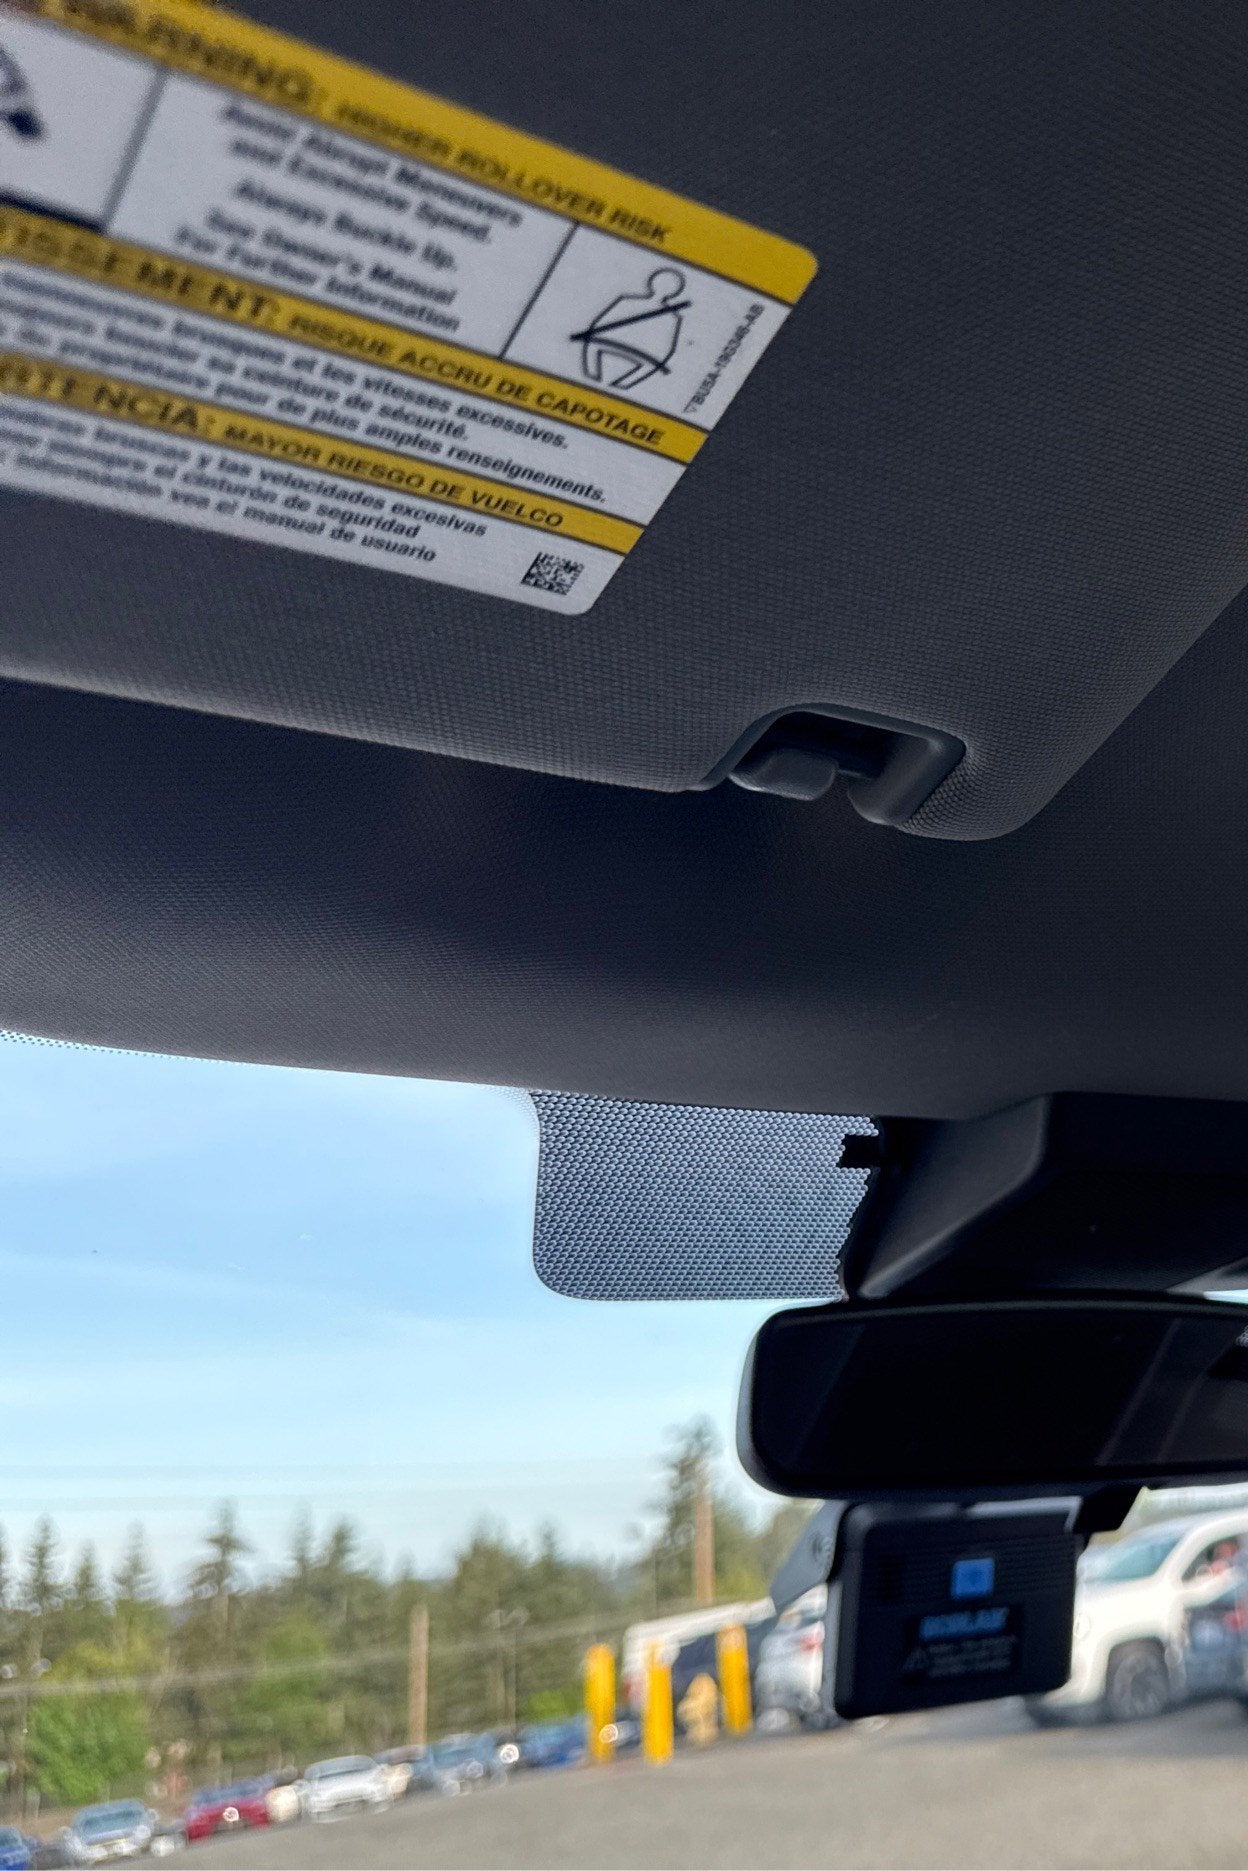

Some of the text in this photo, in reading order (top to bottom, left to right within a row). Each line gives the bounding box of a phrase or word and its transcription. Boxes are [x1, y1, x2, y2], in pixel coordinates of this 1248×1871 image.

[415, 201, 492, 243] Speed.
[453, 149, 605, 217] ROLLOVER
[607, 208, 672, 246] RISK
[369, 263, 457, 304] Manual
[420, 242, 457, 273] Up.
[325, 275, 460, 332] Information
[286, 315, 391, 357] RISQUE
[400, 349, 493, 389] ACCRU
[495, 376, 532, 401] DE
[536, 391, 665, 447] CAPOTAGE
[320, 362, 357, 387] les
[362, 375, 450, 413] vitesses
[455, 405, 568, 450] excessives.
[344, 390, 374, 412] de
[378, 402, 469, 442] sécurité.
[225, 425, 321, 463] MAYOR
[325, 452, 425, 490] RIESGO
[429, 479, 465, 501] DE
[469, 490, 564, 529] VUELCO
[277, 396, 307, 417] de
[310, 406, 358, 432] plus
[364, 423, 443, 458] amples
[446, 446, 606, 504] renseignements.
[182, 470, 278, 504] cinturón
[283, 494, 311, 513] de
[316, 502, 421, 540] seguridad
[243, 507, 325, 536] manual
[329, 526, 355, 543] de
[361, 534, 437, 564] usuario
[259, 468, 385, 509] velocidades
[390, 502, 487, 538] excesivas
